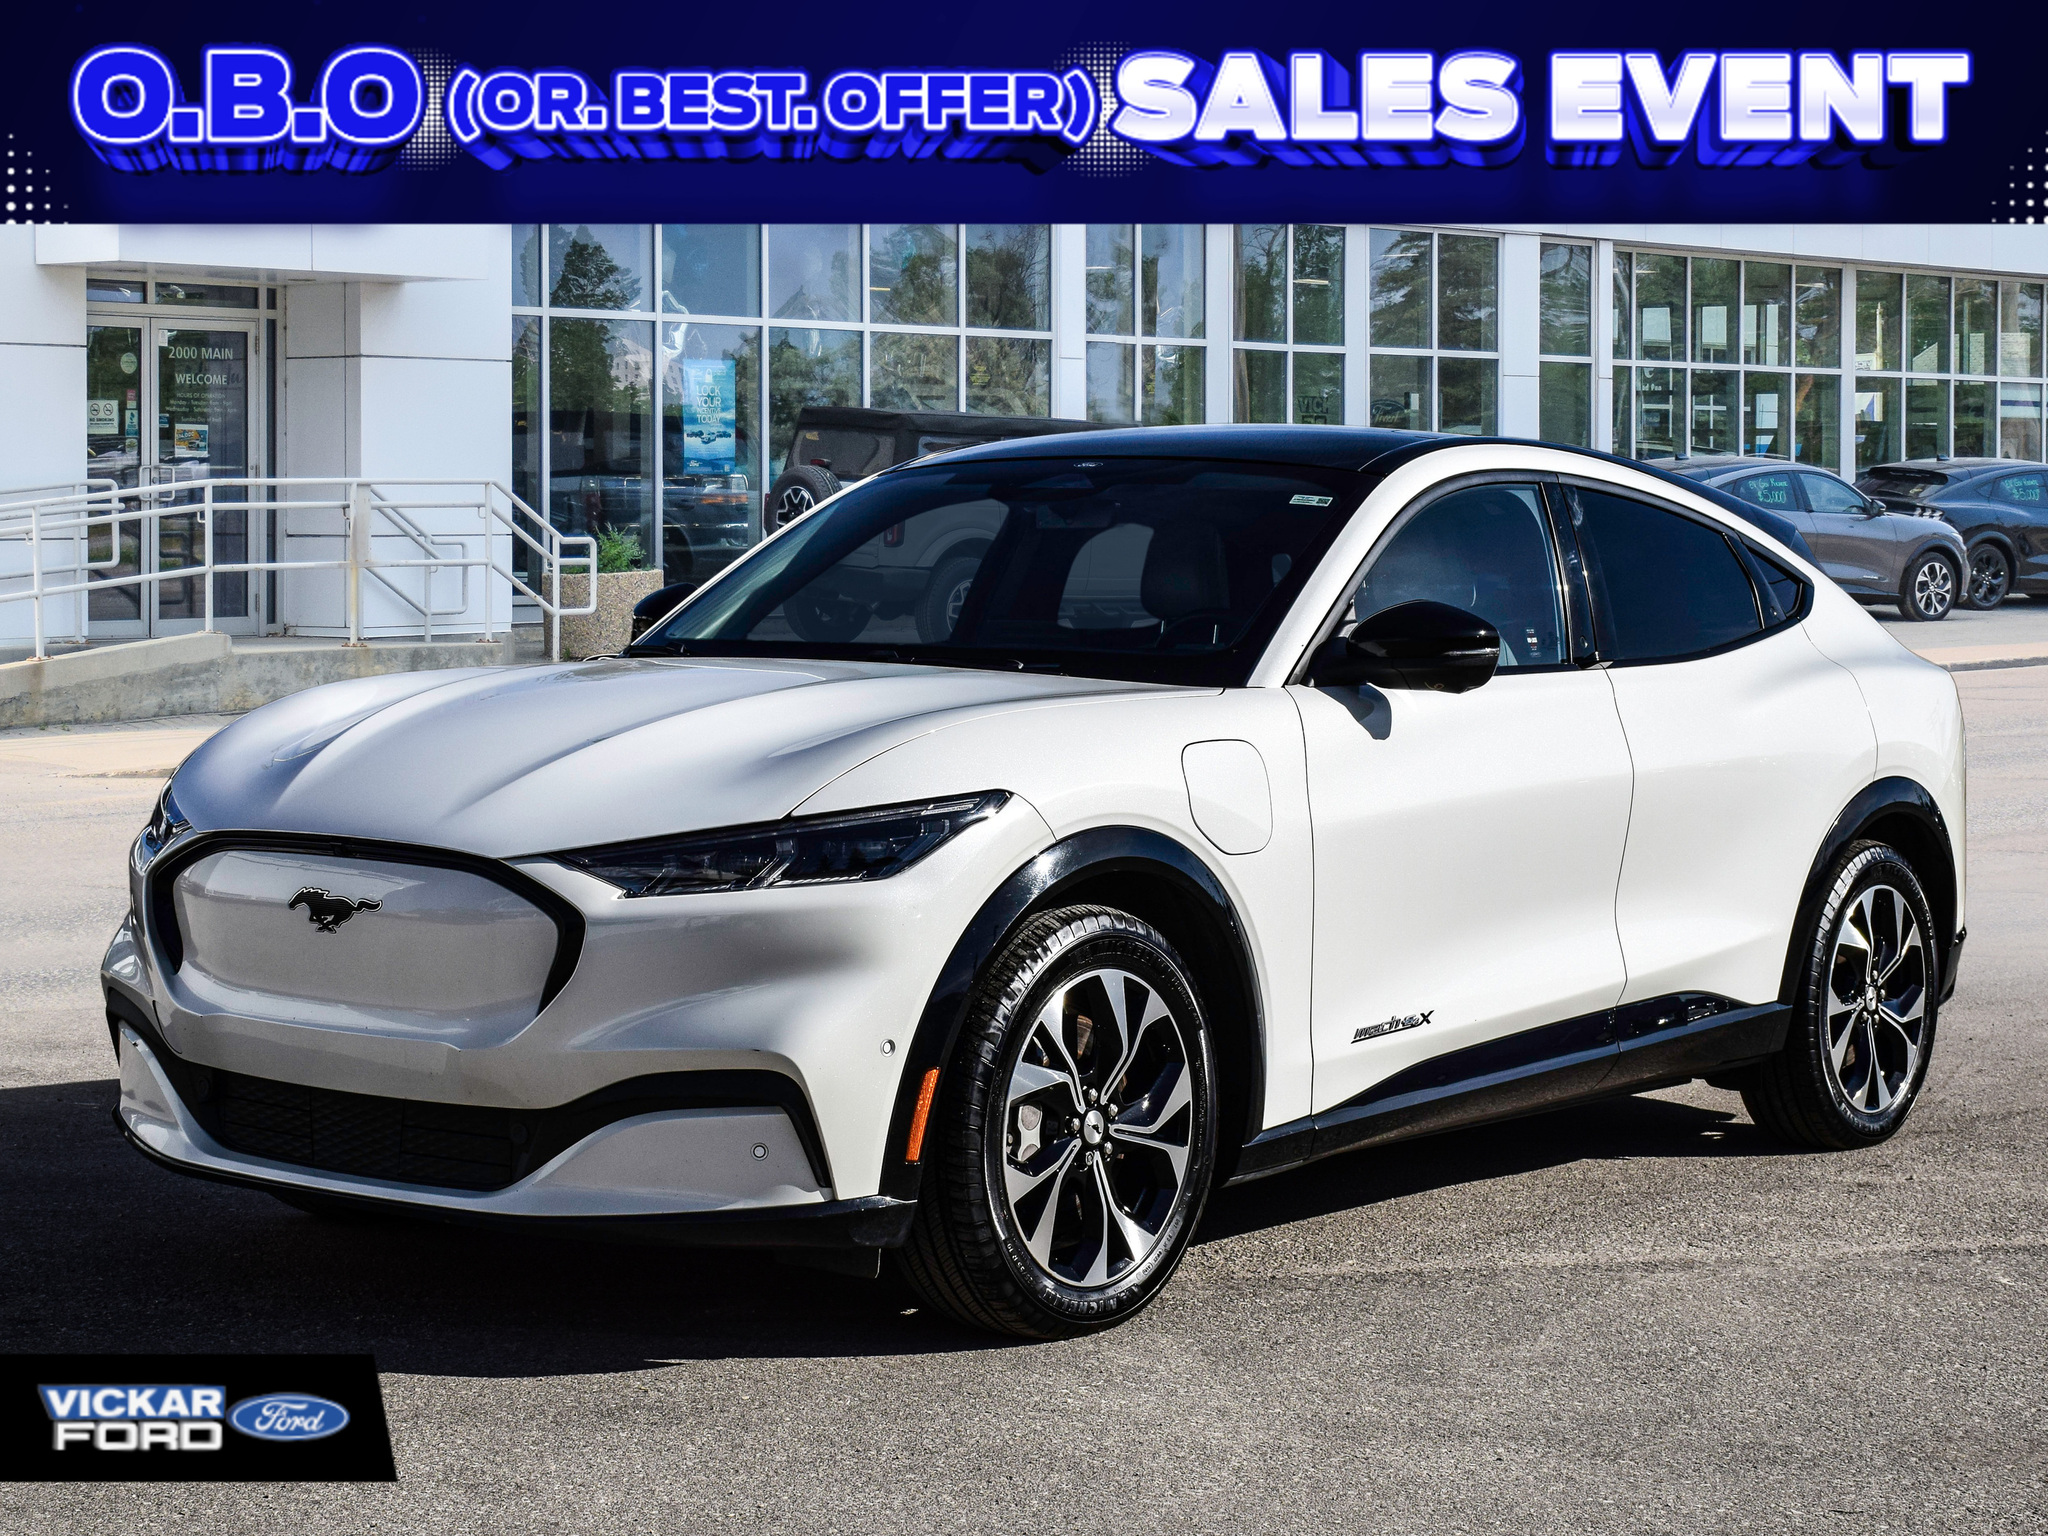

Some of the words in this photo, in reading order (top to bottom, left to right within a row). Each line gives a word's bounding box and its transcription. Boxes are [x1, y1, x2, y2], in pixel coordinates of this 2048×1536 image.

[168, 346, 198, 359] 2000
[201, 347, 233, 360] MAIN
[175, 373, 228, 385] WELCOME
[696, 385, 721, 396] LOCK
[696, 396, 722, 408] YOUR
[696, 414, 721, 424] TODAY
